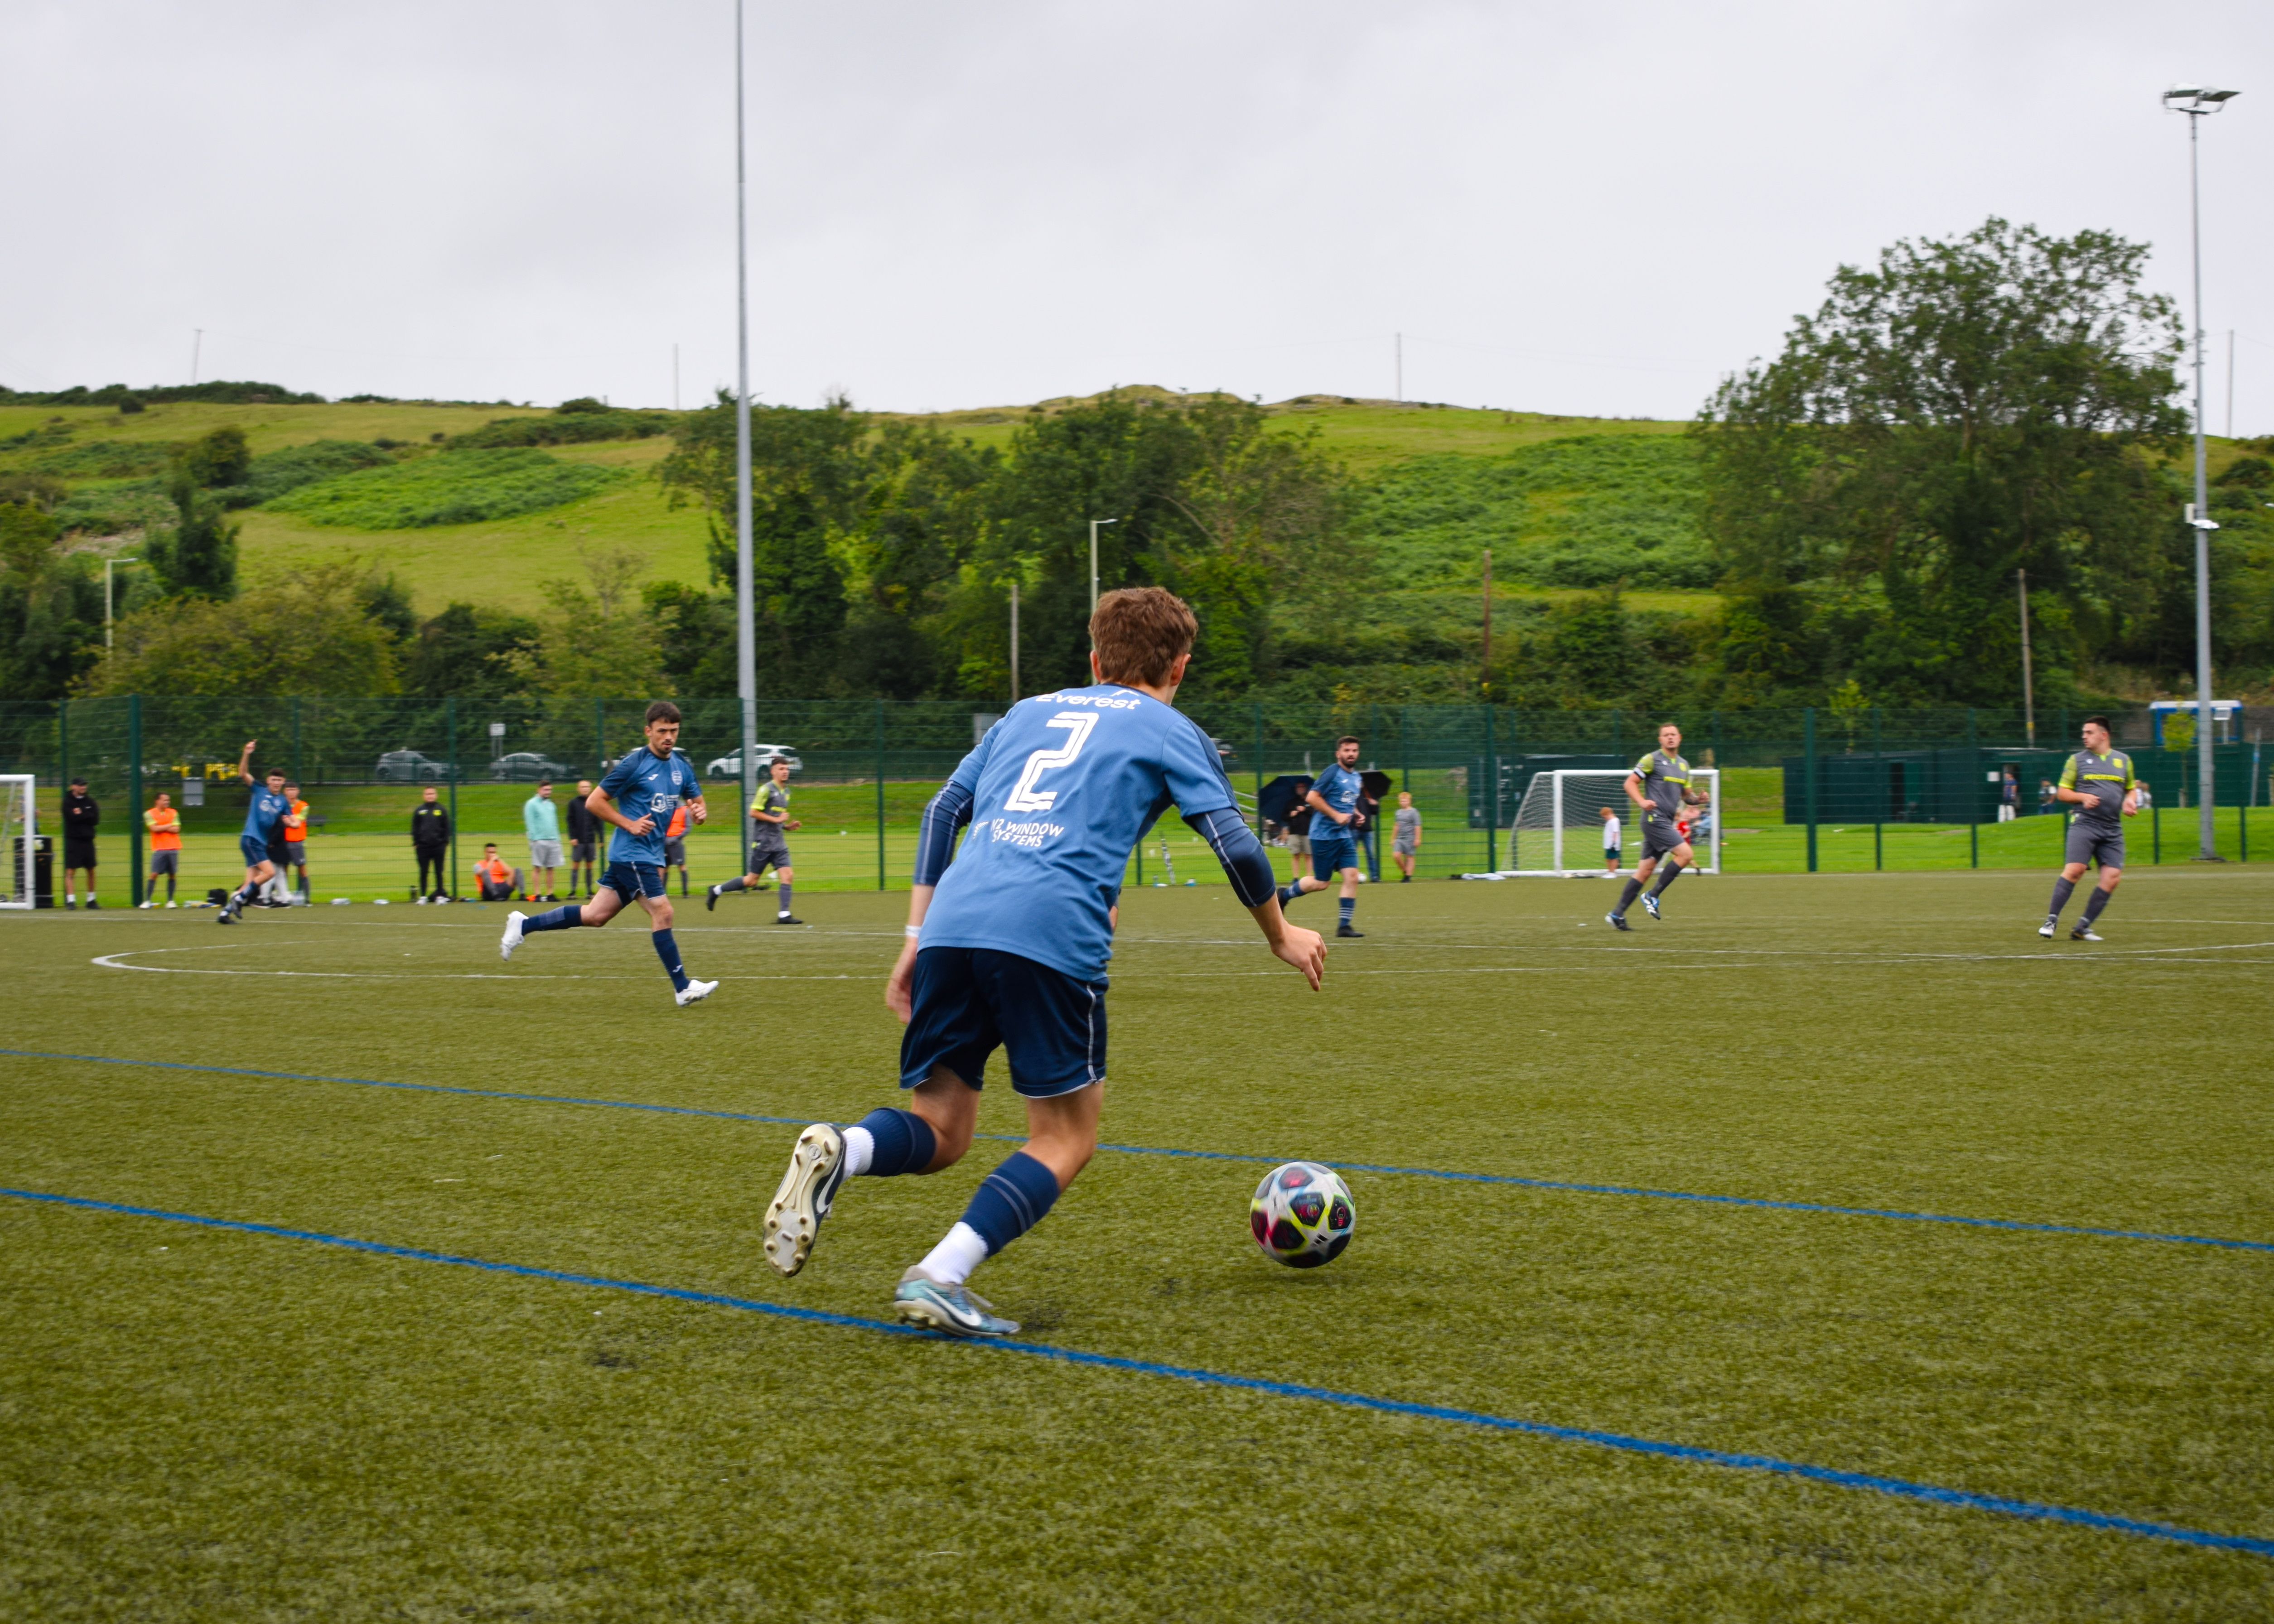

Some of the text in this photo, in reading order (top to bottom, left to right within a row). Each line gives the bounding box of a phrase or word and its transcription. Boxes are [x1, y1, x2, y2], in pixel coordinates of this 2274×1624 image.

[1035, 693, 1142, 710] Everest
[1004, 711, 1099, 812] 2
[1006, 821, 1065, 837] WINDOW
[991, 829, 1044, 847] SYSTEMS
